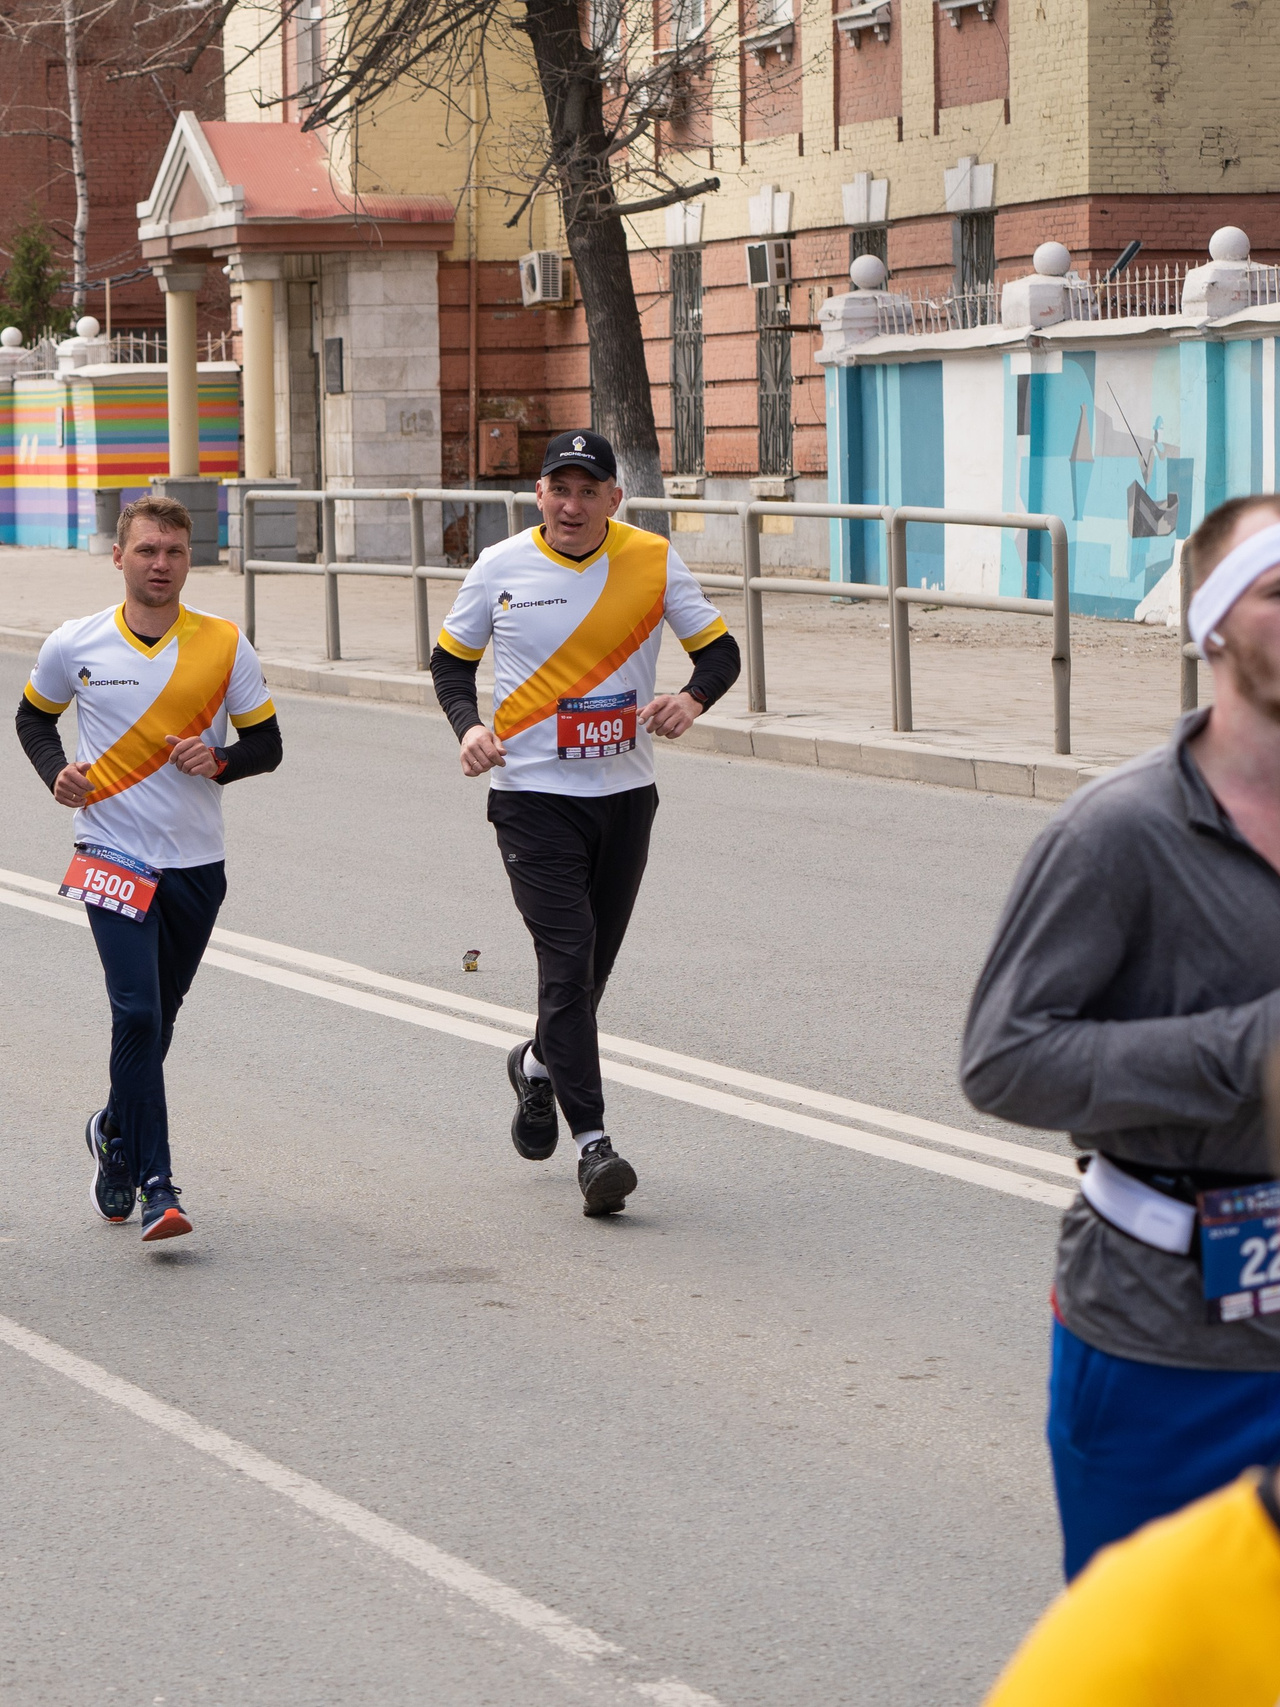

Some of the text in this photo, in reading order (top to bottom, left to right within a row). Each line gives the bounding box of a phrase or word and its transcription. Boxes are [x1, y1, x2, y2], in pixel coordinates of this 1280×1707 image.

[510, 598, 567, 609] РОСНЕФТЬ
[577, 718, 623, 744] 1499
[107, 851, 136, 865] ПРОСТО
[83, 868, 135, 901] 1500
